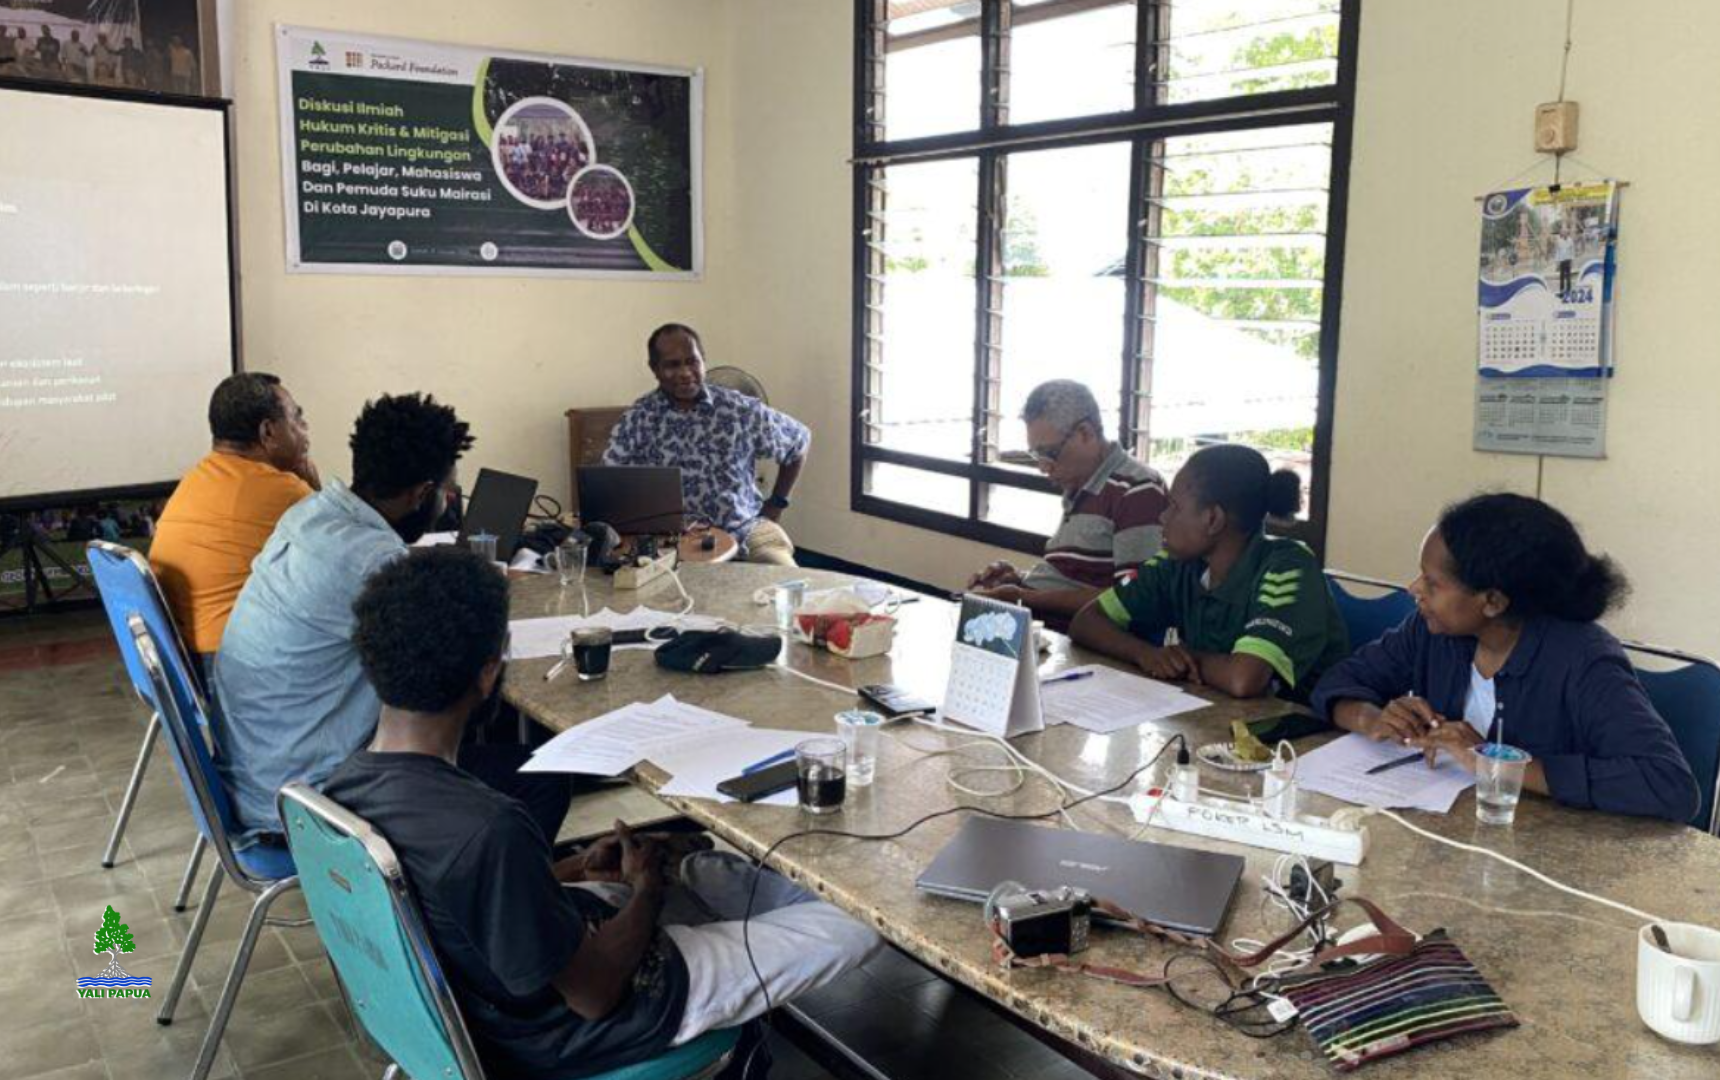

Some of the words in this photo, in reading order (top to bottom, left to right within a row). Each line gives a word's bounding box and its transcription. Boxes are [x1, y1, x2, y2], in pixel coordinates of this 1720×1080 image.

[371, 58, 406, 72] Packard
[409, 60, 459, 76] Foundation
[299, 98, 353, 115] Diskusi
[357, 103, 404, 118] Ilmiah
[300, 120, 355, 134] Hukum
[358, 123, 396, 137] Kritis
[399, 126, 410, 138] &
[413, 126, 470, 143] Mitigasi
[300, 140, 384, 156] Perubahan
[387, 145, 472, 163] Lingkungan
[302, 160, 339, 176] Bagi,
[343, 162, 399, 180] Pelajar,
[402, 165, 482, 182] Mahasiswa
[303, 181, 333, 194] Dan
[336, 182, 398, 197] Pemuda
[401, 186, 437, 199] Suku
[440, 188, 491, 201] Mairasi
[304, 201, 318, 213] Di
[322, 201, 357, 215] Kota
[360, 203, 431, 220] Jayapura
